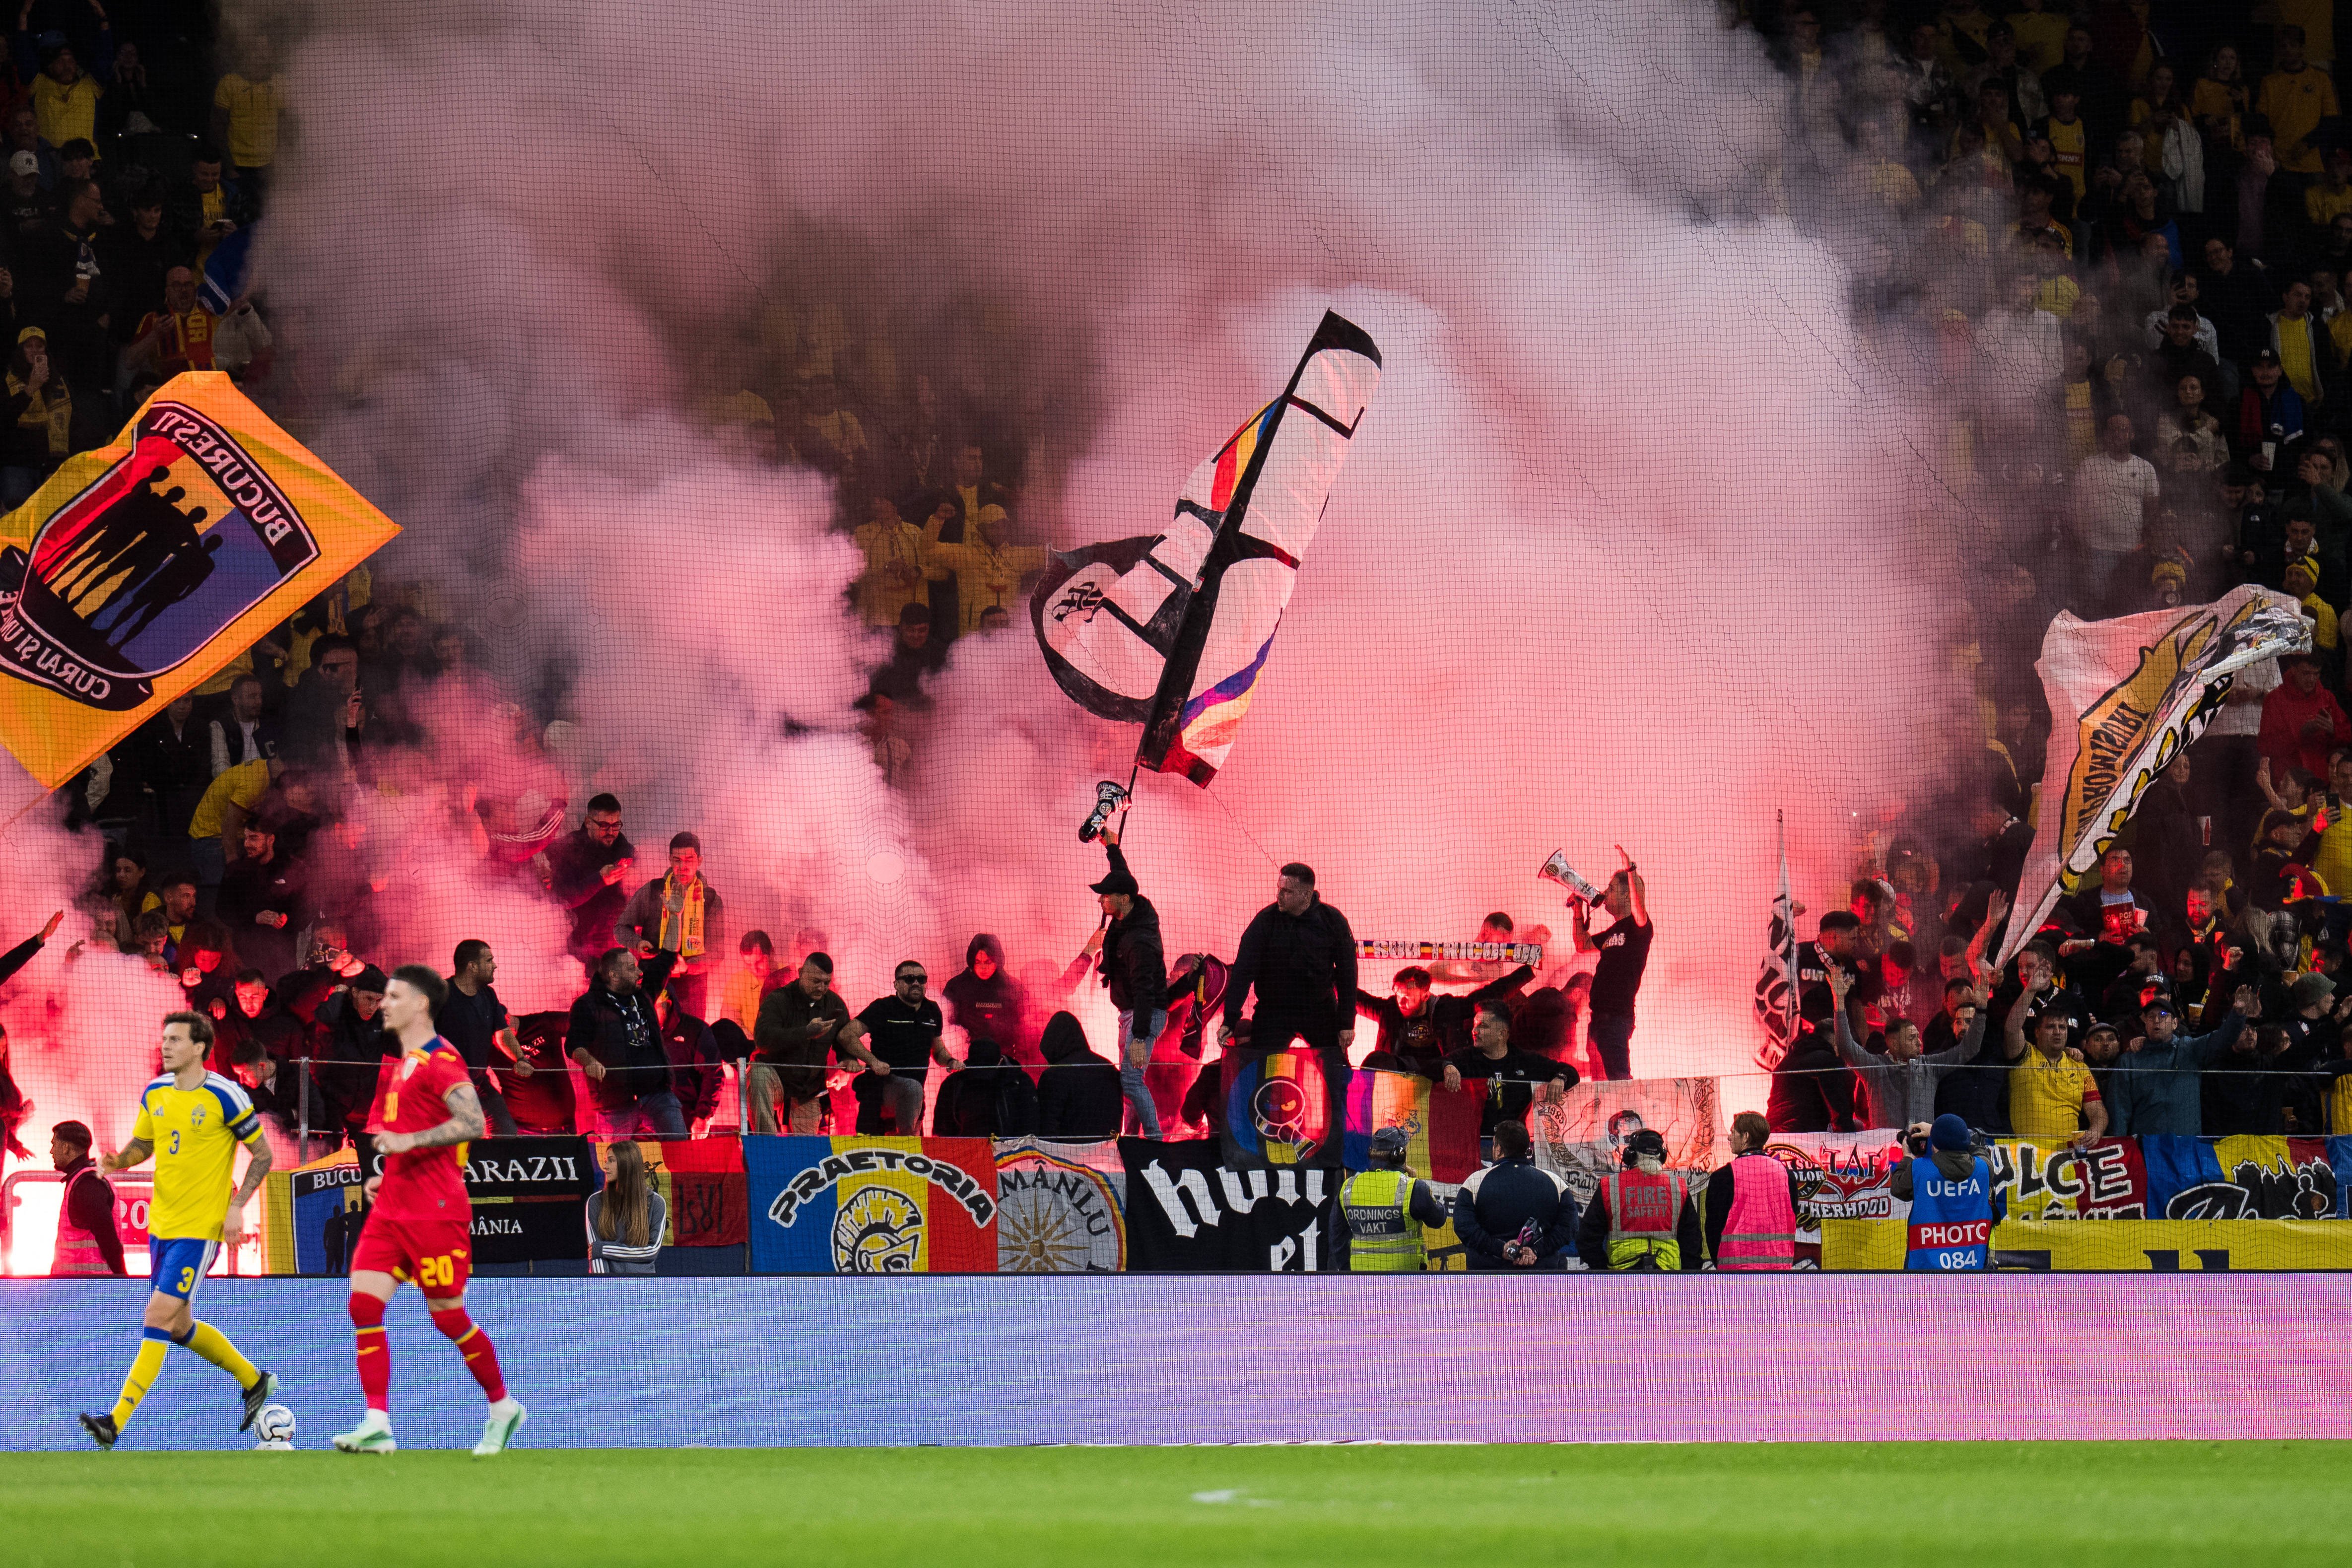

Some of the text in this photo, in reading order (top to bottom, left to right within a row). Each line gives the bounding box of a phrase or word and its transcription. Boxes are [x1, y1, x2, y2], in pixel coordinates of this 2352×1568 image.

[1372, 941, 1421, 959] SUB
[169, 1129, 181, 1155] 3
[769, 1150, 995, 1227] PRAETORIA
[1625, 1186, 1668, 1205] FIRE
[1927, 1178, 1981, 1197] UEFA
[998, 1159, 1111, 1236] MÂNLU
[1347, 1209, 1400, 1220] ORDNINGS
[1627, 1206, 1668, 1218] SAFETY
[1359, 1222, 1387, 1234] VAKT
[1939, 1250, 1977, 1269] 084
[176, 1266, 195, 1293] 3
[419, 1255, 454, 1288] 20
